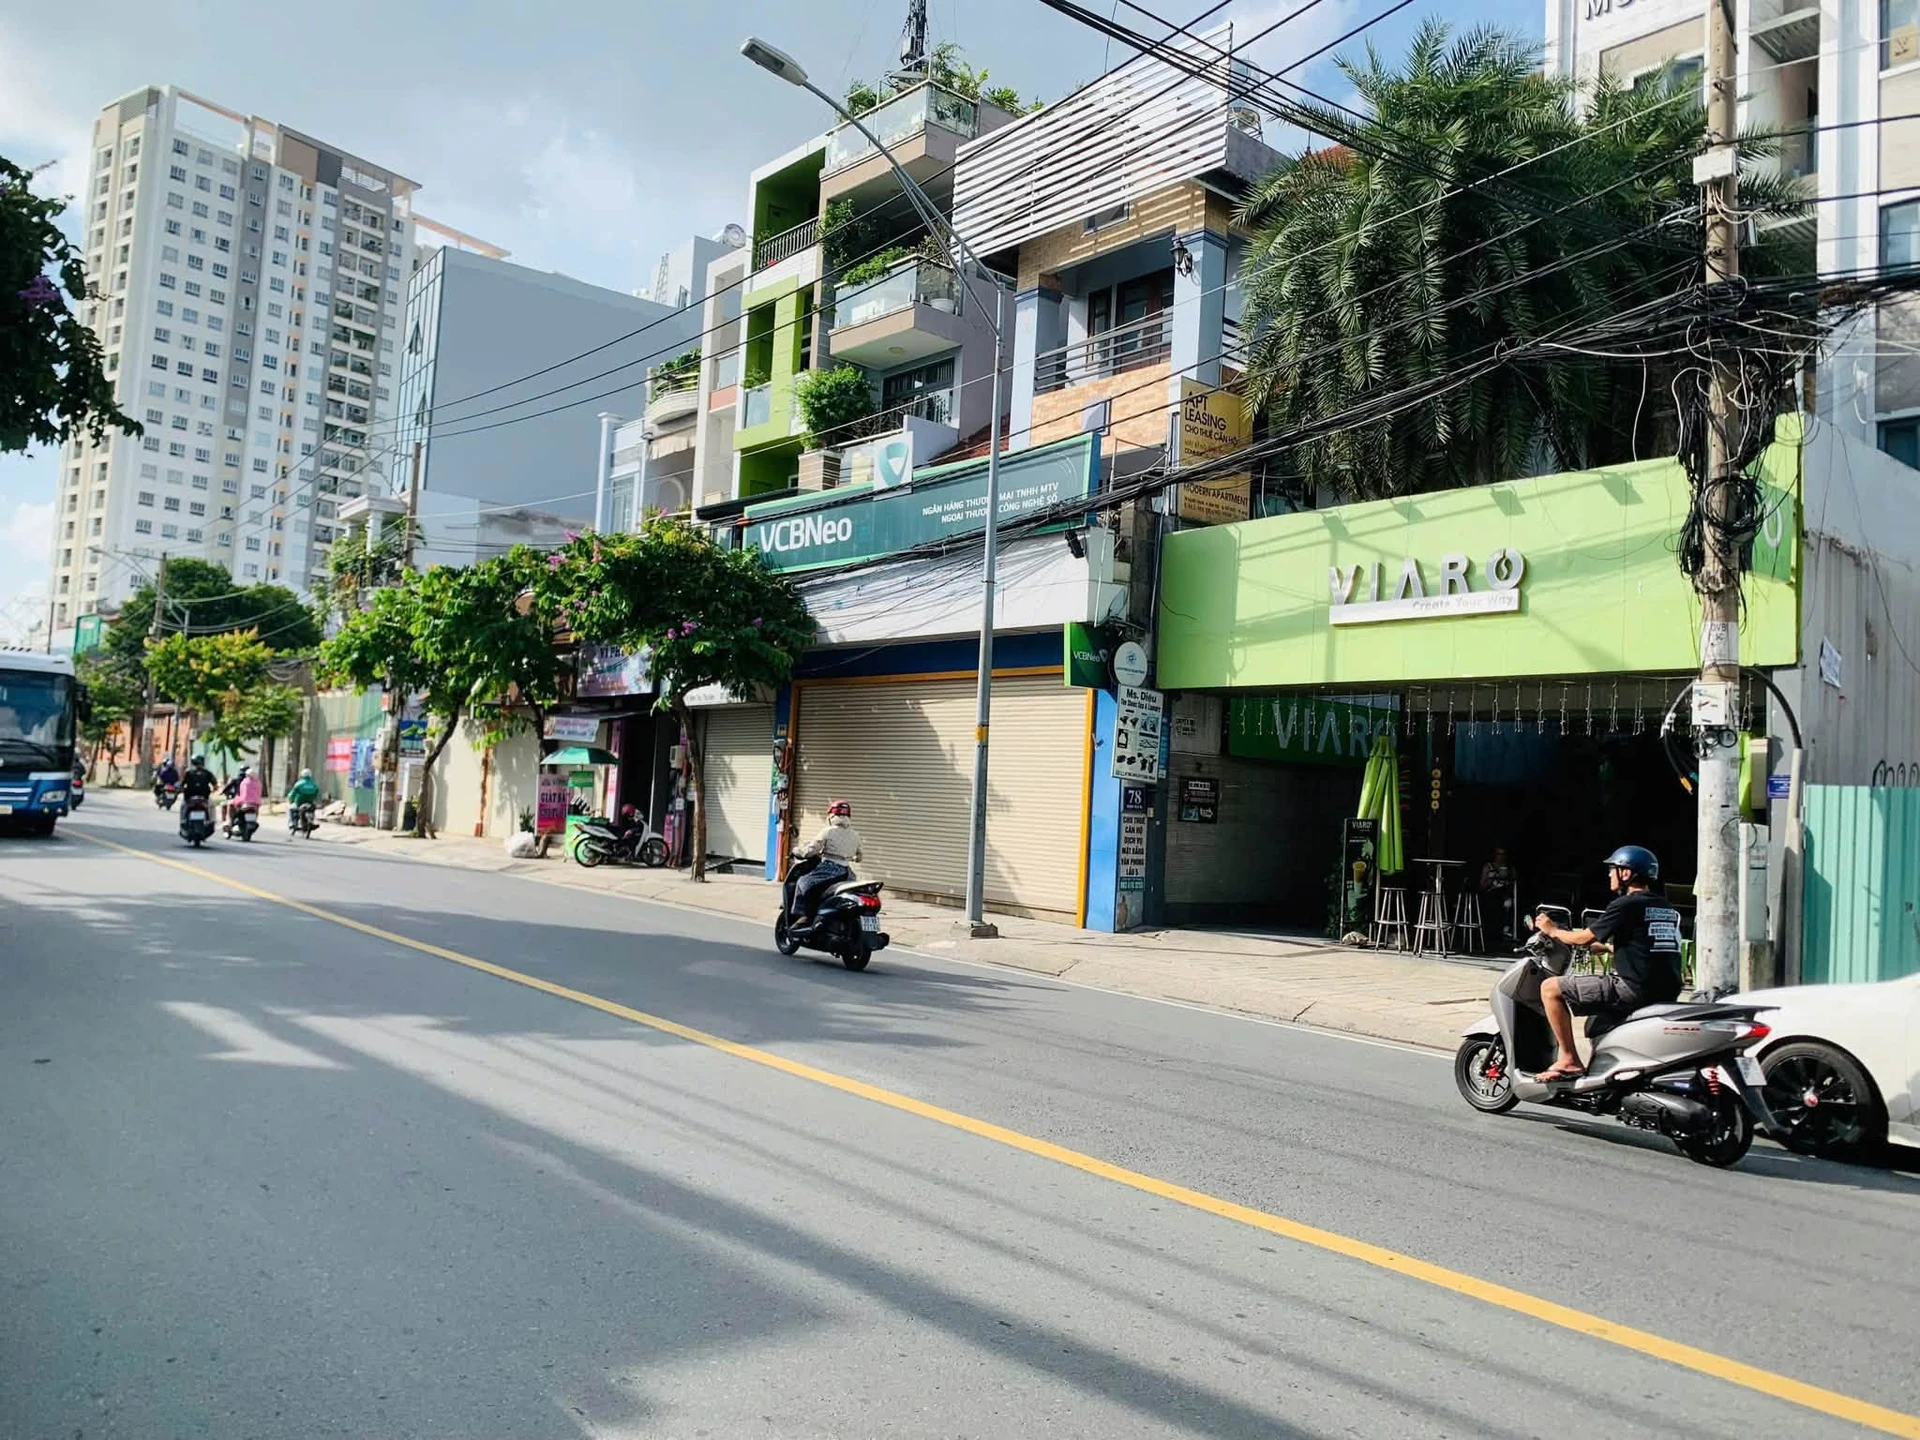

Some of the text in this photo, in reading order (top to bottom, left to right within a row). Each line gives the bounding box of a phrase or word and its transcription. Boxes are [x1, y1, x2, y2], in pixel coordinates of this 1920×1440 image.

[1185, 391, 1209, 411] APT
[1184, 406, 1227, 431] LEASING
[1184, 424, 1200, 434] CHO
[1199, 427, 1213, 439] THUÊ
[922, 503, 943, 516] NGÂN
[943, 499, 964, 511] HÀNG
[999, 492, 1014, 502] MẠI
[1016, 487, 1039, 498] TNHH
[1040, 481, 1059, 494] MTV
[941, 511, 964, 524] NGOẠI
[998, 502, 1020, 514] CÔNG
[1022, 496, 1046, 508] NGHỆ
[1047, 492, 1059, 505] SỐ
[760, 514, 852, 553] VCBNeo
[1328, 547, 1525, 605] VIARO
[1487, 593, 1514, 608] Way
[1072, 650, 1101, 663] VCBNeo
[1126, 689, 1139, 700] Ms.
[1127, 789, 1141, 804] 78
